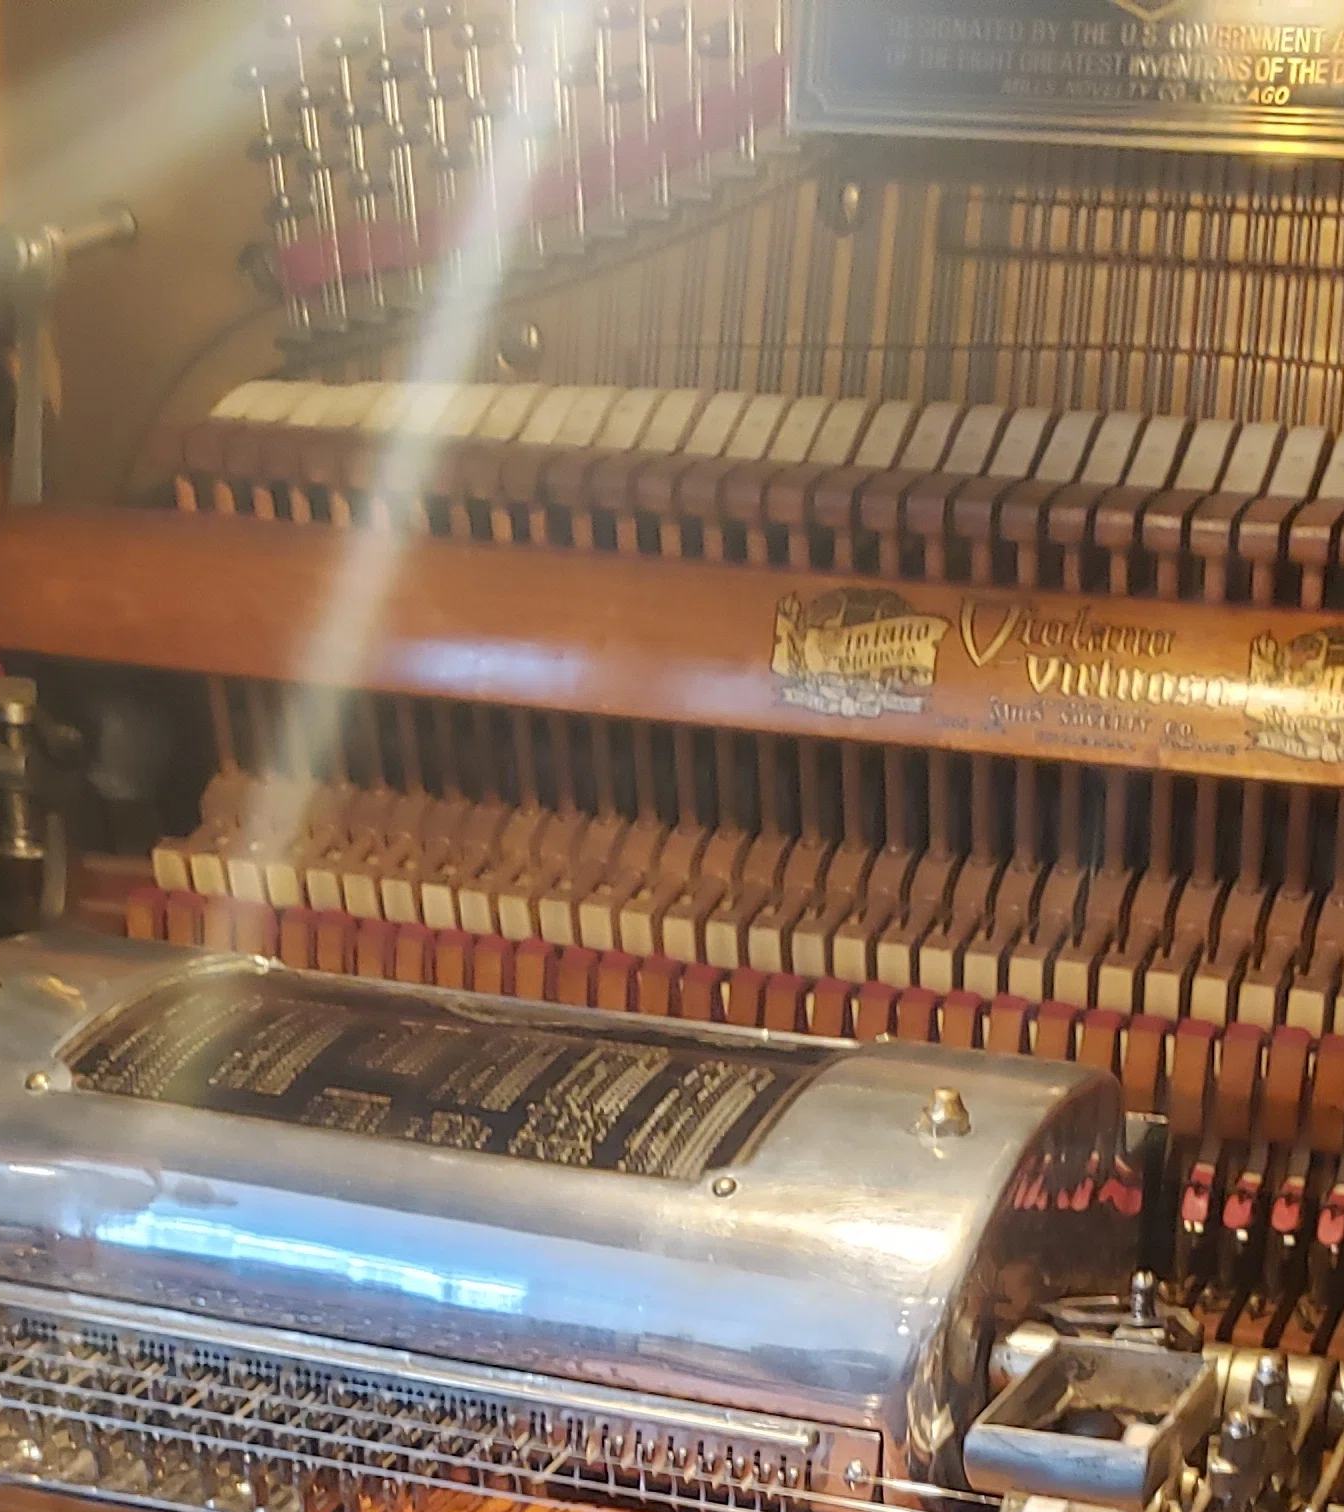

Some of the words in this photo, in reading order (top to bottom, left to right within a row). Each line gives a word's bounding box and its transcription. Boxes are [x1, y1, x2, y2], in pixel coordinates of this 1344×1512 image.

[1072, 20, 1113, 47] THE
[1169, 23, 1327, 53] GOVERNMENT
[1129, 54, 1253, 83] INVENTIONS
[1256, 56, 1287, 83] OF
[1287, 57, 1331, 86] THE
[1198, 84, 1290, 105] CHICAGO
